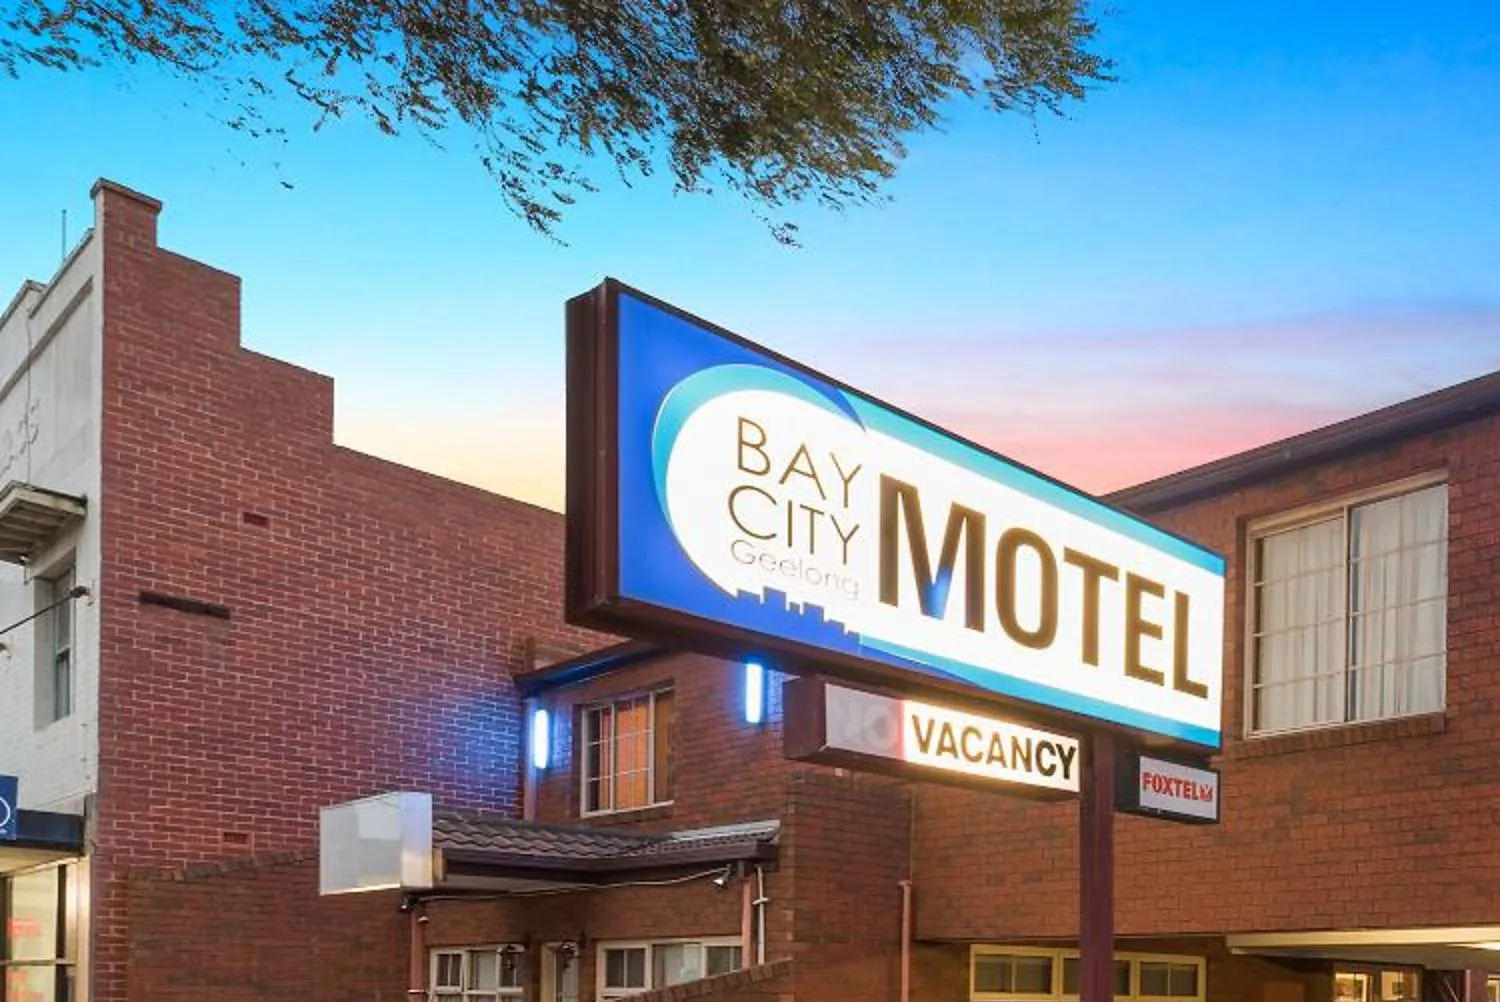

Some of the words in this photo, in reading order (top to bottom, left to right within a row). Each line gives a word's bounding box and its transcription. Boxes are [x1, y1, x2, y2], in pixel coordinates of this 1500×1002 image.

[738, 416, 862, 508] BAY
[728, 485, 860, 564] CITY
[730, 539, 859, 598] Geelong
[879, 473, 1208, 698] MOTEL
[911, 715, 1077, 779] VACANCY
[1142, 771, 1200, 800] FOXTEL
